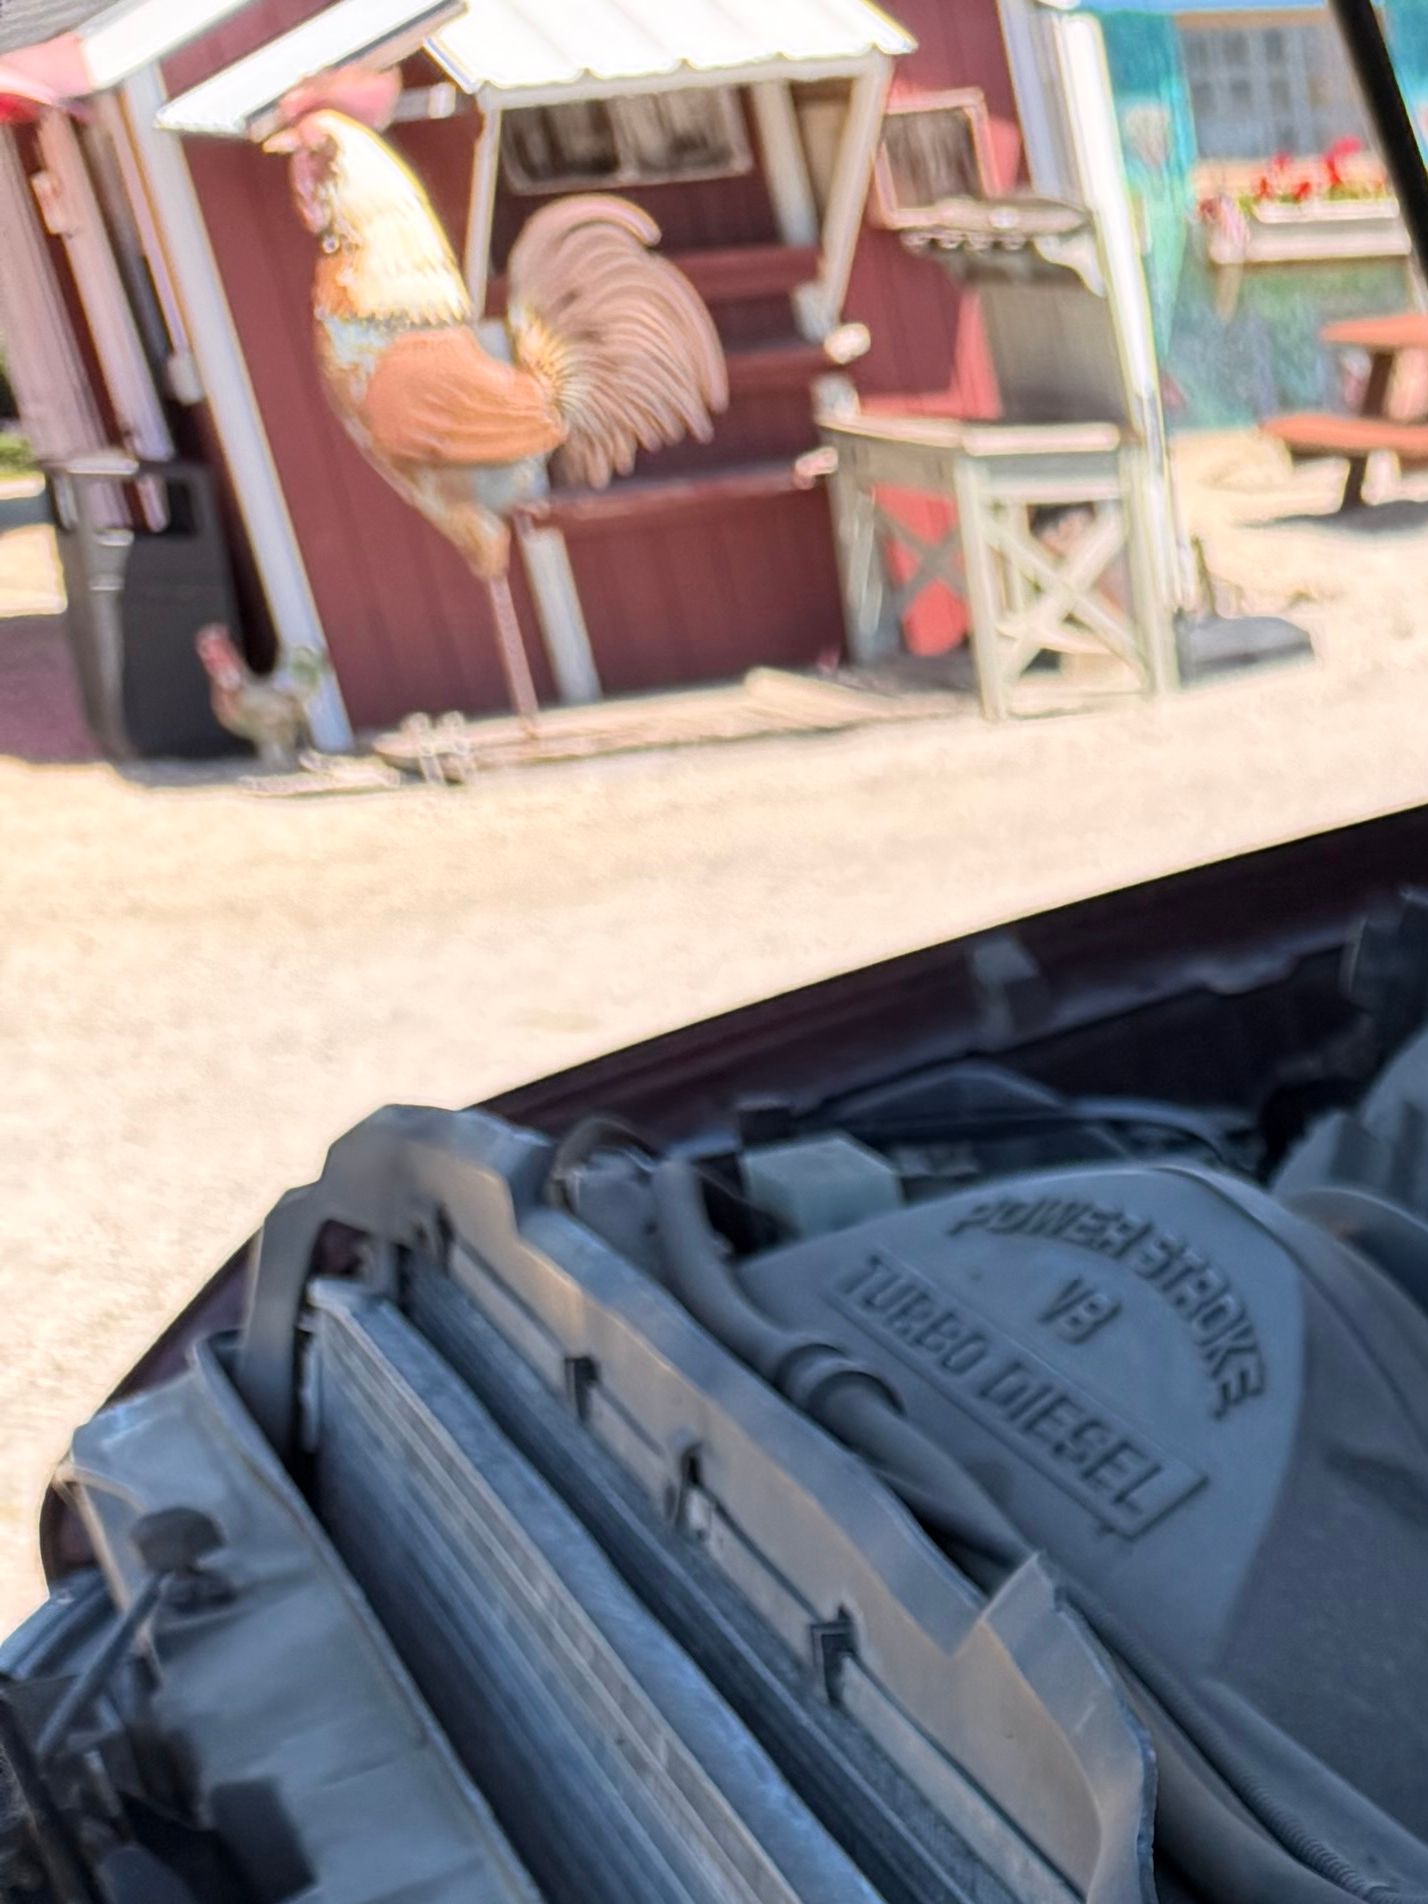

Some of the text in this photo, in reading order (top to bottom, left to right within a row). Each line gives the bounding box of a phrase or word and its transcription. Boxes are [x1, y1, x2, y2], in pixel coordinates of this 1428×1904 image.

[840, 1253, 1163, 1518] TURBO DIESEL
[947, 1199, 1266, 1421] POWER STROKE
[1037, 1274, 1123, 1345] V8
